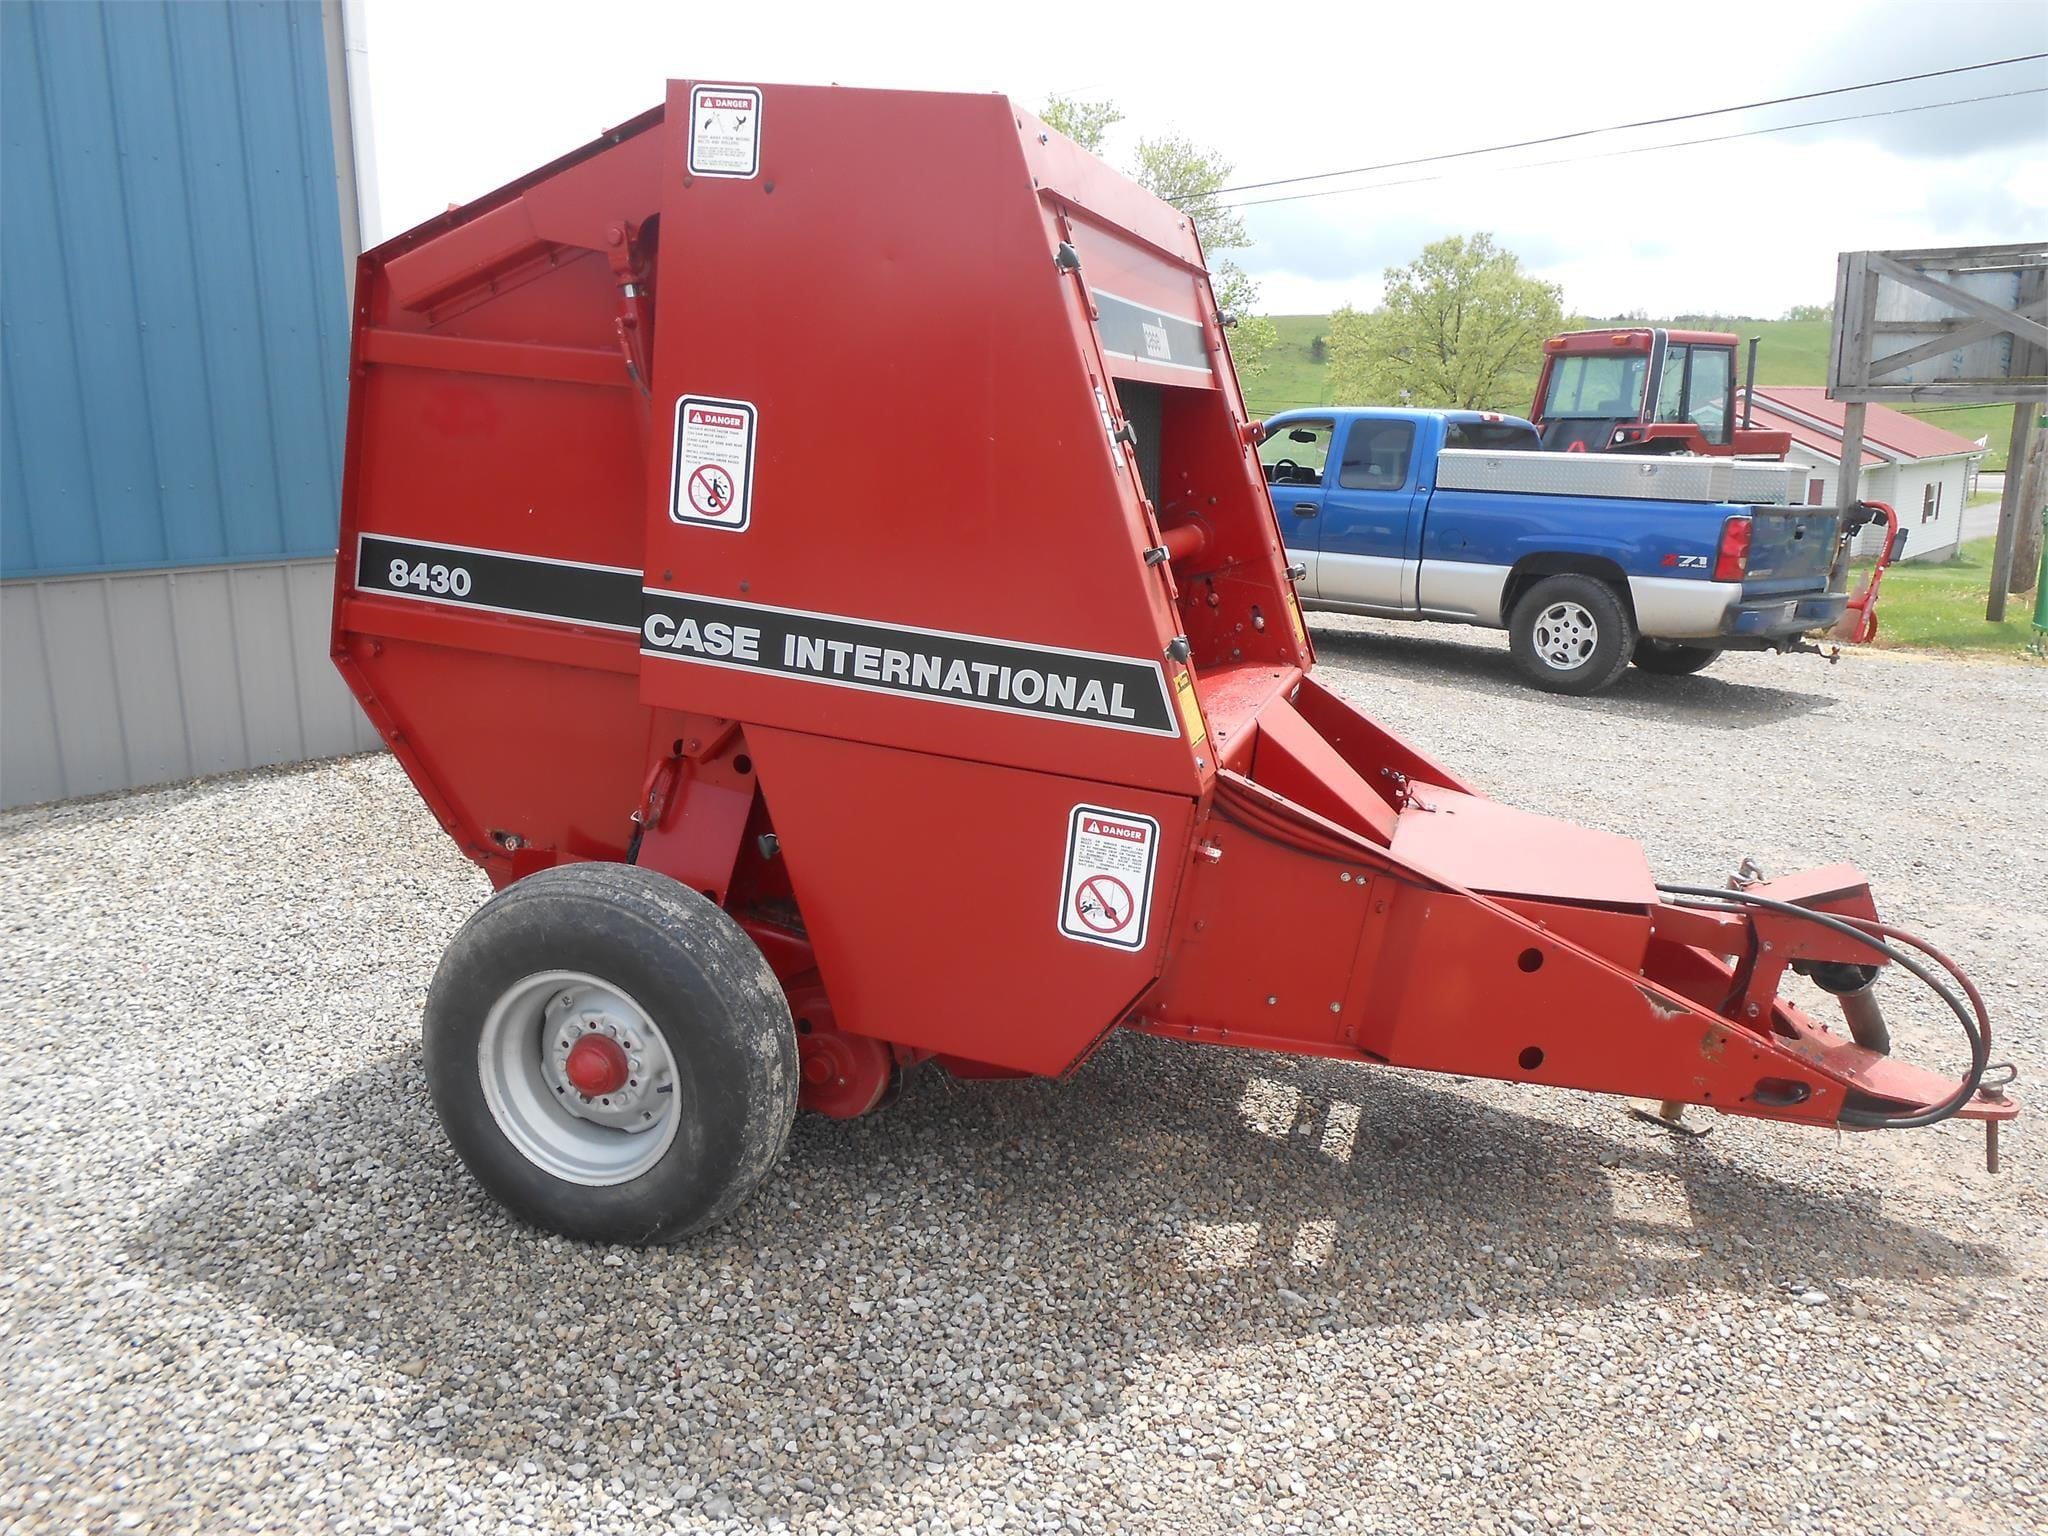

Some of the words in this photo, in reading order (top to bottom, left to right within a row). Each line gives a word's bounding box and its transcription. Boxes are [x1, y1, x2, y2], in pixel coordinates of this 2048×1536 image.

[715, 99, 748, 108] DANGER
[705, 415, 740, 426] DANGER
[1663, 554, 1707, 566] Z71
[388, 558, 472, 597] 8430
[644, 613, 760, 660] CASE
[784, 634, 1136, 718] INTERNATIONAL
[1102, 826, 1141, 839] DANGER
